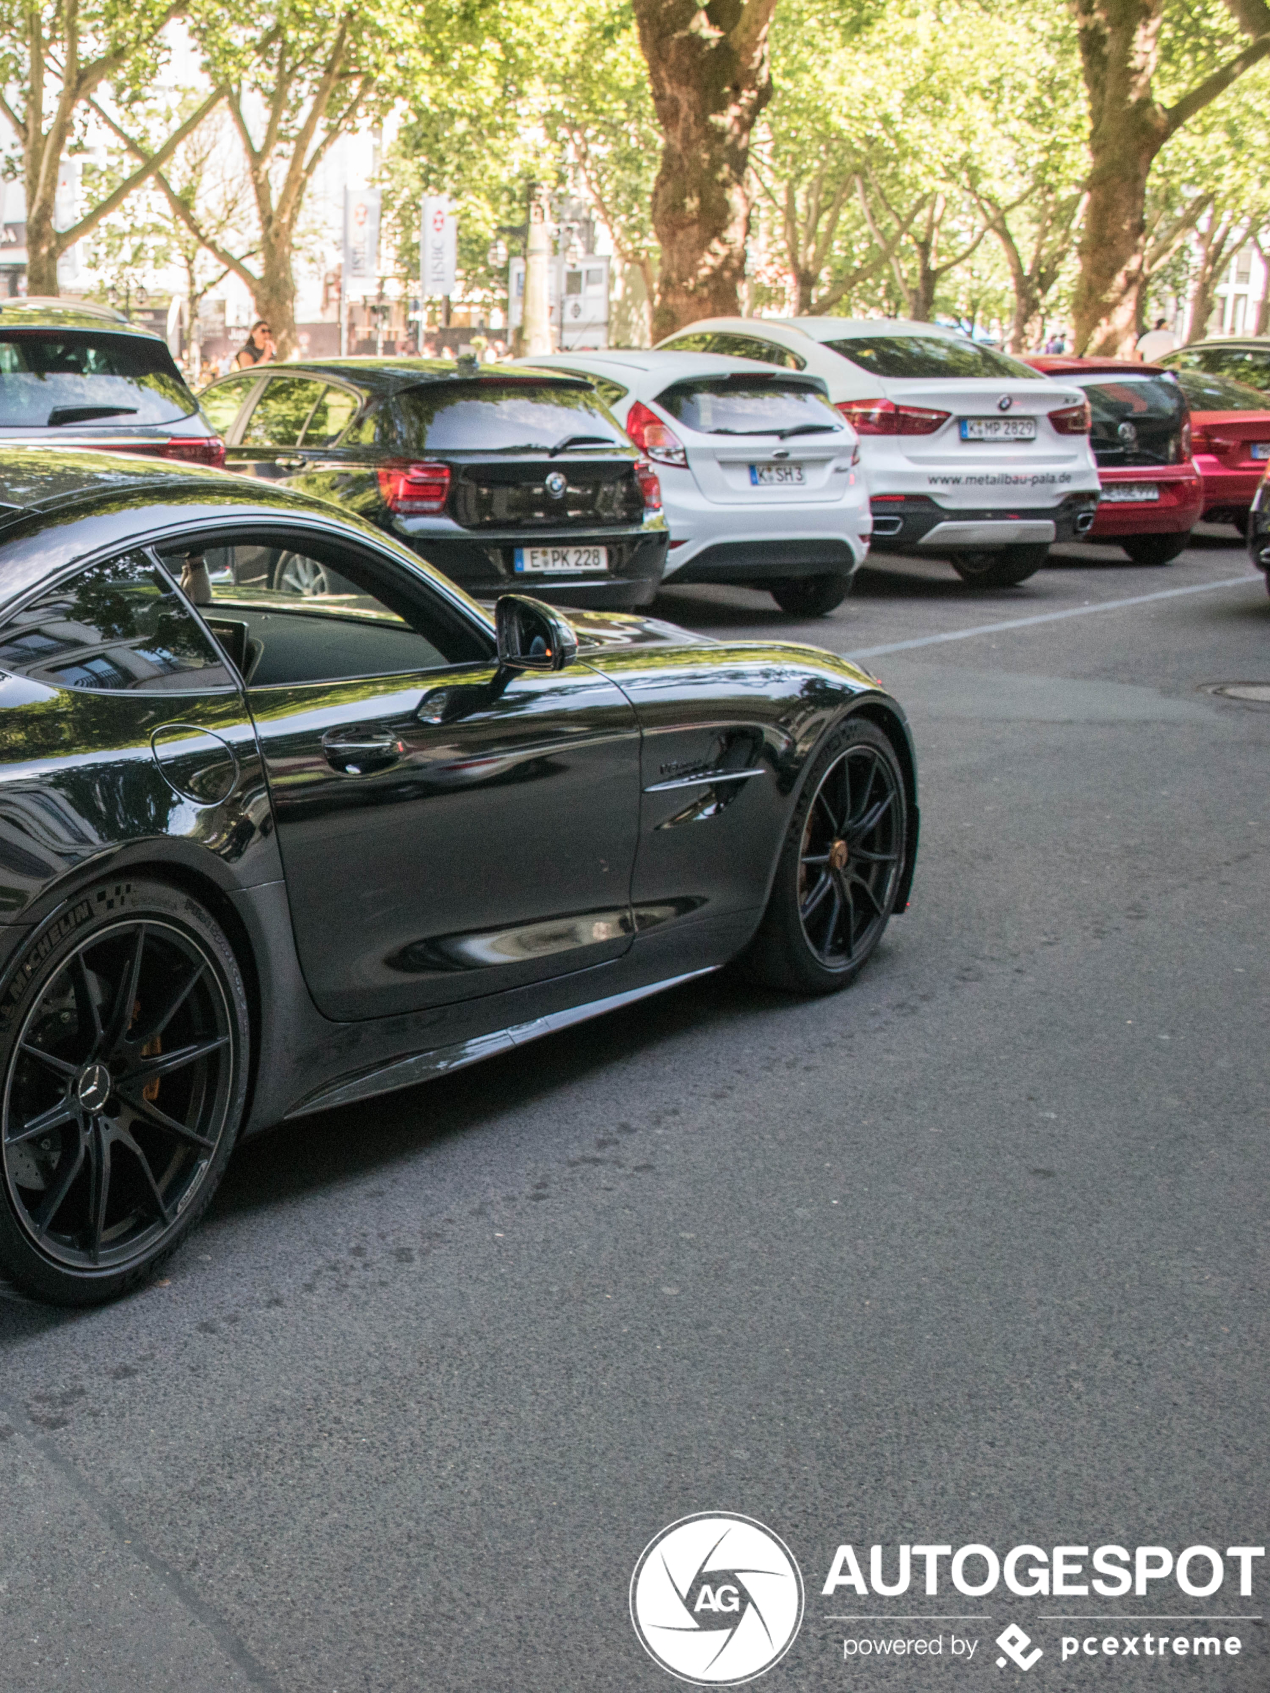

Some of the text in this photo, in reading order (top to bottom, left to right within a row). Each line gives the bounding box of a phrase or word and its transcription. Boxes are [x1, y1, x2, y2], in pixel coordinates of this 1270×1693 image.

[431, 239, 446, 282] HSBC
[968, 421, 1034, 436] K MP 2829
[757, 466, 804, 482] K SH 3
[530, 549, 600, 568] E PK 228
[8, 900, 92, 1001] MICHELIN
